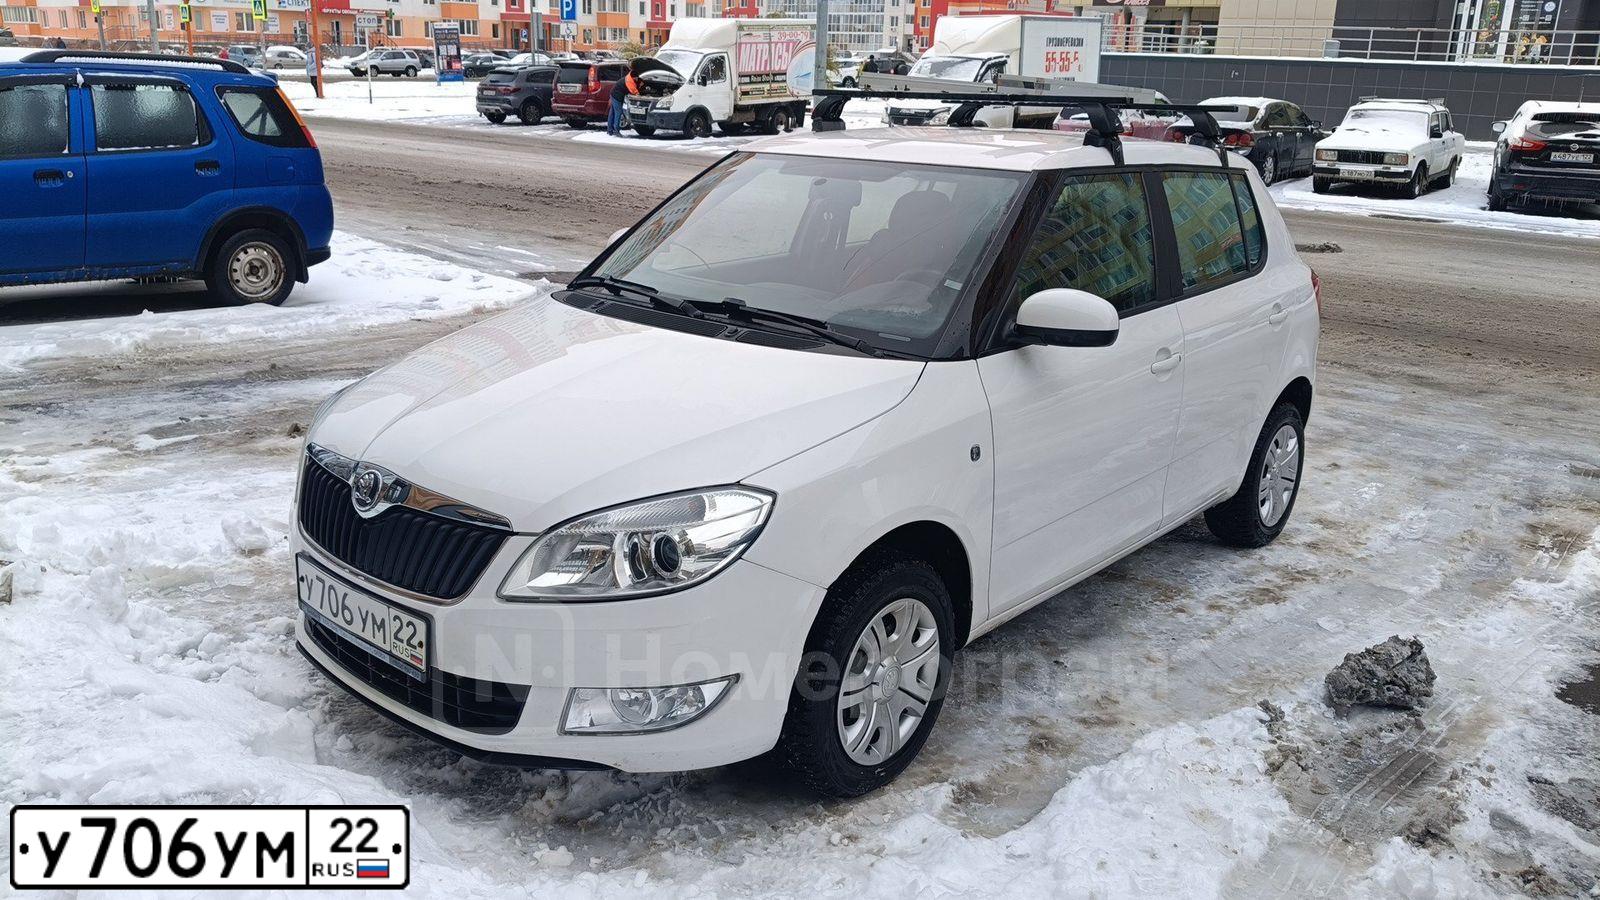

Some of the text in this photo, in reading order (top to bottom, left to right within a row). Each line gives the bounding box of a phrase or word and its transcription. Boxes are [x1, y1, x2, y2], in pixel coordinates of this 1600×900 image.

[305, 574, 418, 650] У706УМ 22
[392, 641, 410, 657] RUS
